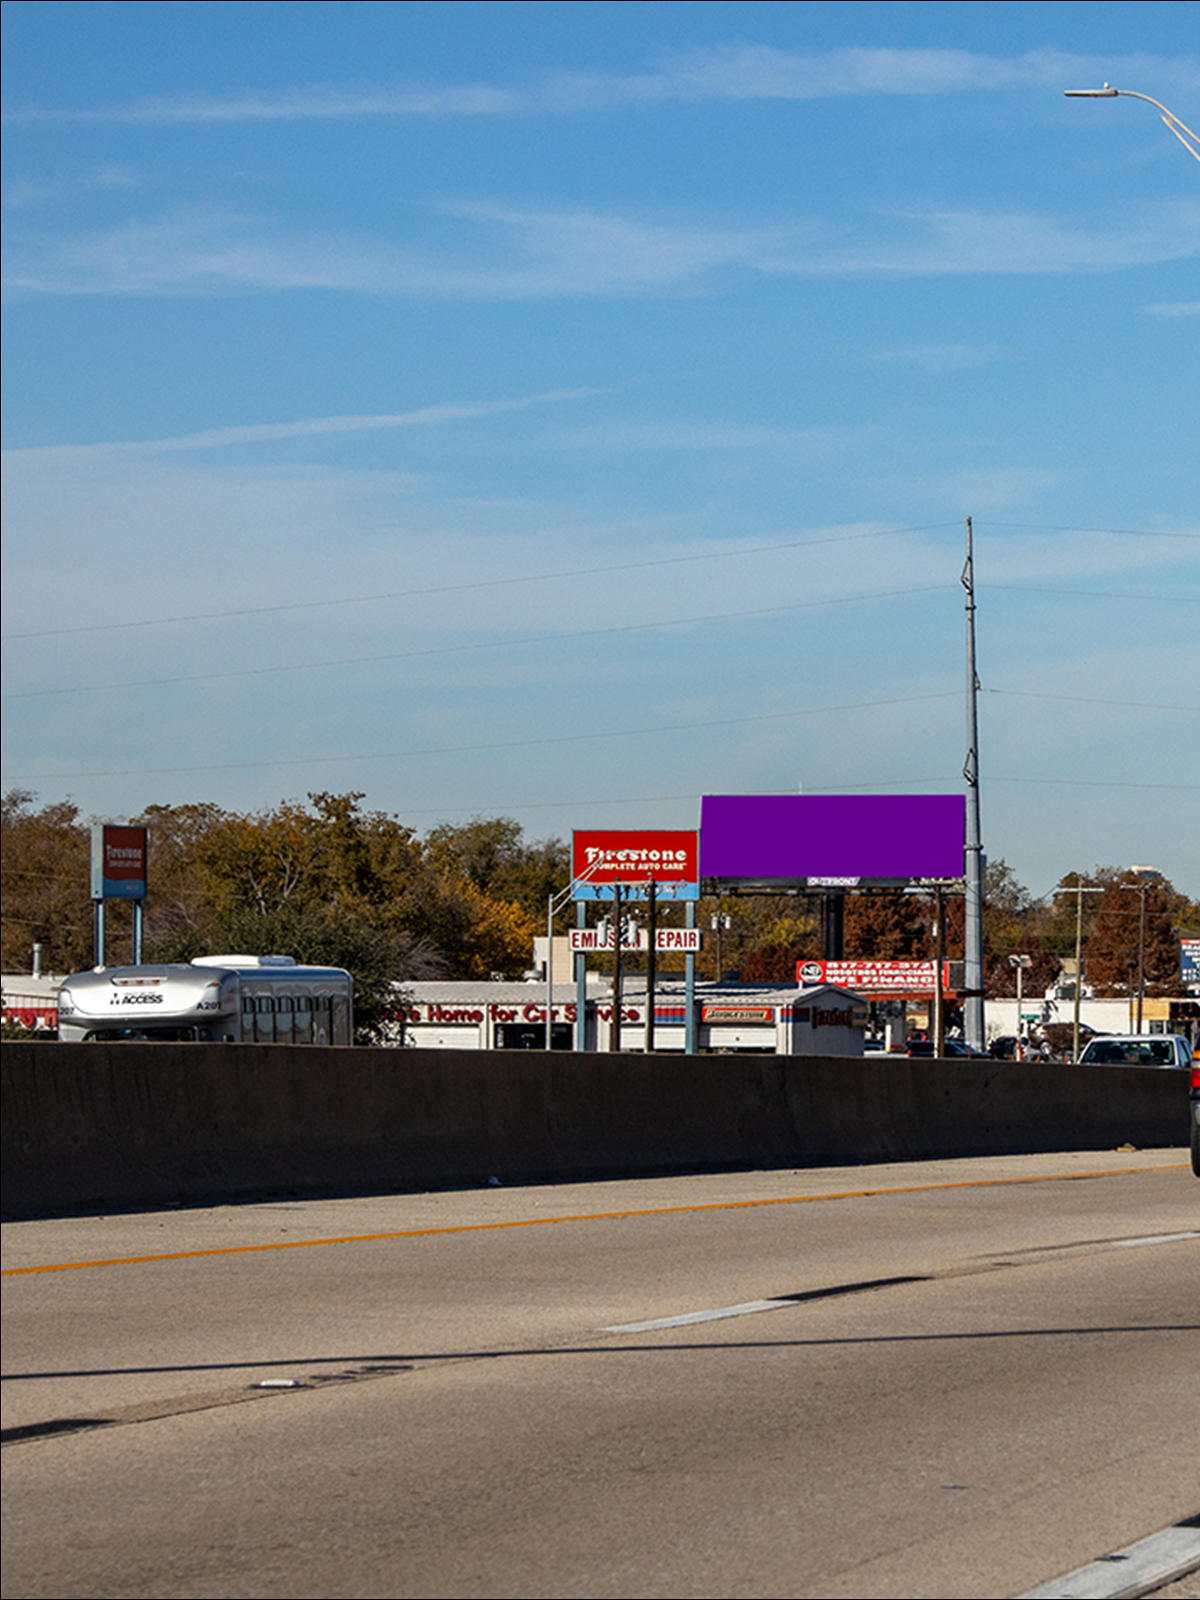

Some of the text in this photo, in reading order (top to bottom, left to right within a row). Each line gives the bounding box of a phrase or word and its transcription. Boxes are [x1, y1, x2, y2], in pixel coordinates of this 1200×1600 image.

[585, 847, 687, 864] Firestone
[657, 931, 697, 948] EPAIR
[122, 995, 163, 1004] ACCESS
[427, 1005, 484, 1022] Home
[491, 1005, 517, 1022] for
[523, 1005, 558, 1022] Car
[564, 1004, 639, 1022] Srvce
